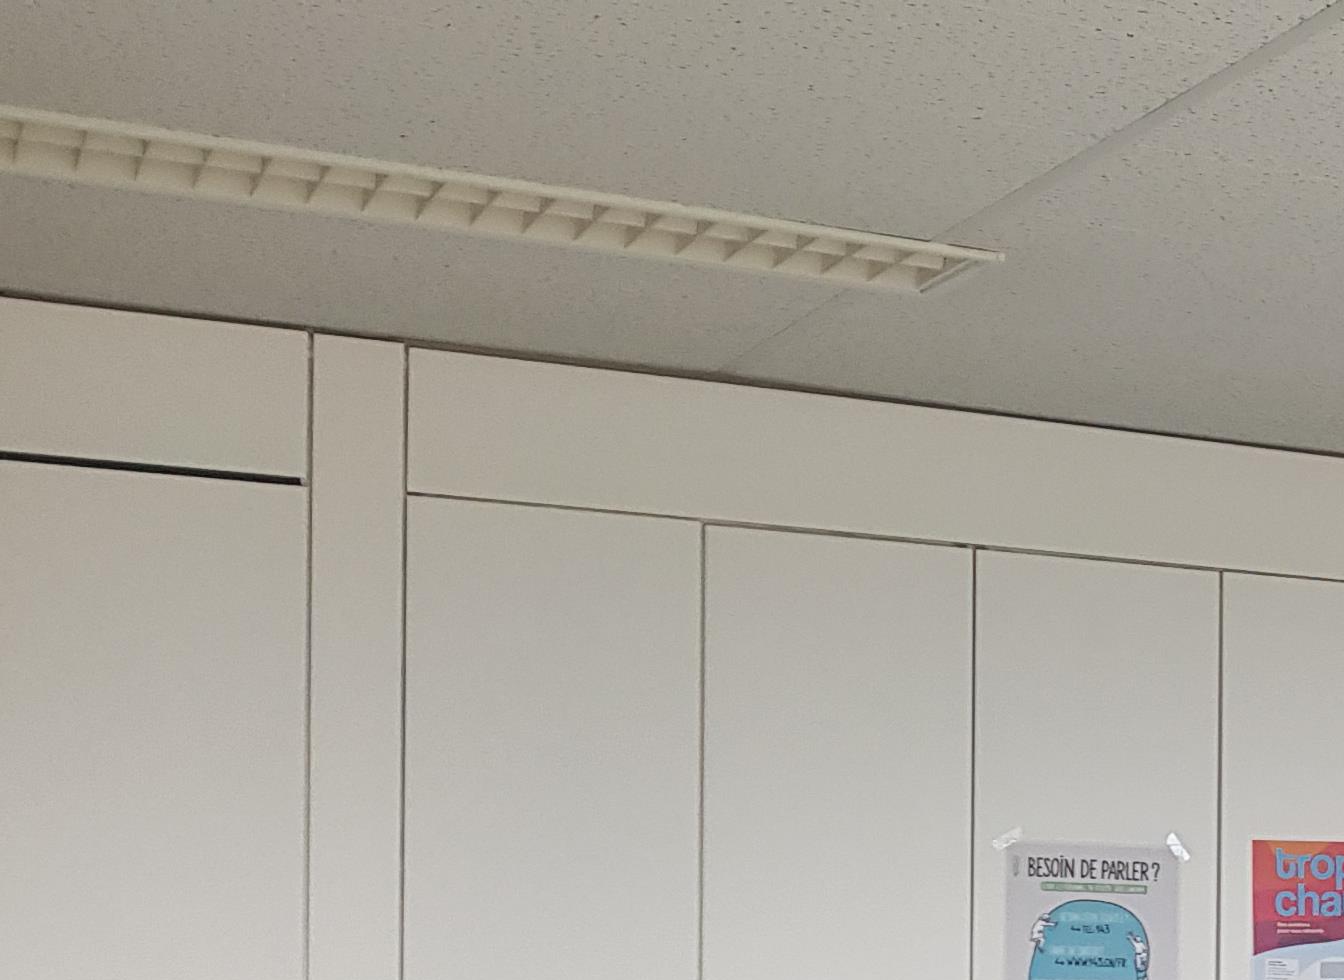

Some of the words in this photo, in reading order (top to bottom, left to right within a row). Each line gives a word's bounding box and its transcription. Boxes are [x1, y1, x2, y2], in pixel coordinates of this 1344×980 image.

[1027, 855, 1075, 878] BESOIN
[1080, 859, 1098, 879] DE
[1101, 860, 1149, 881] PARLER
